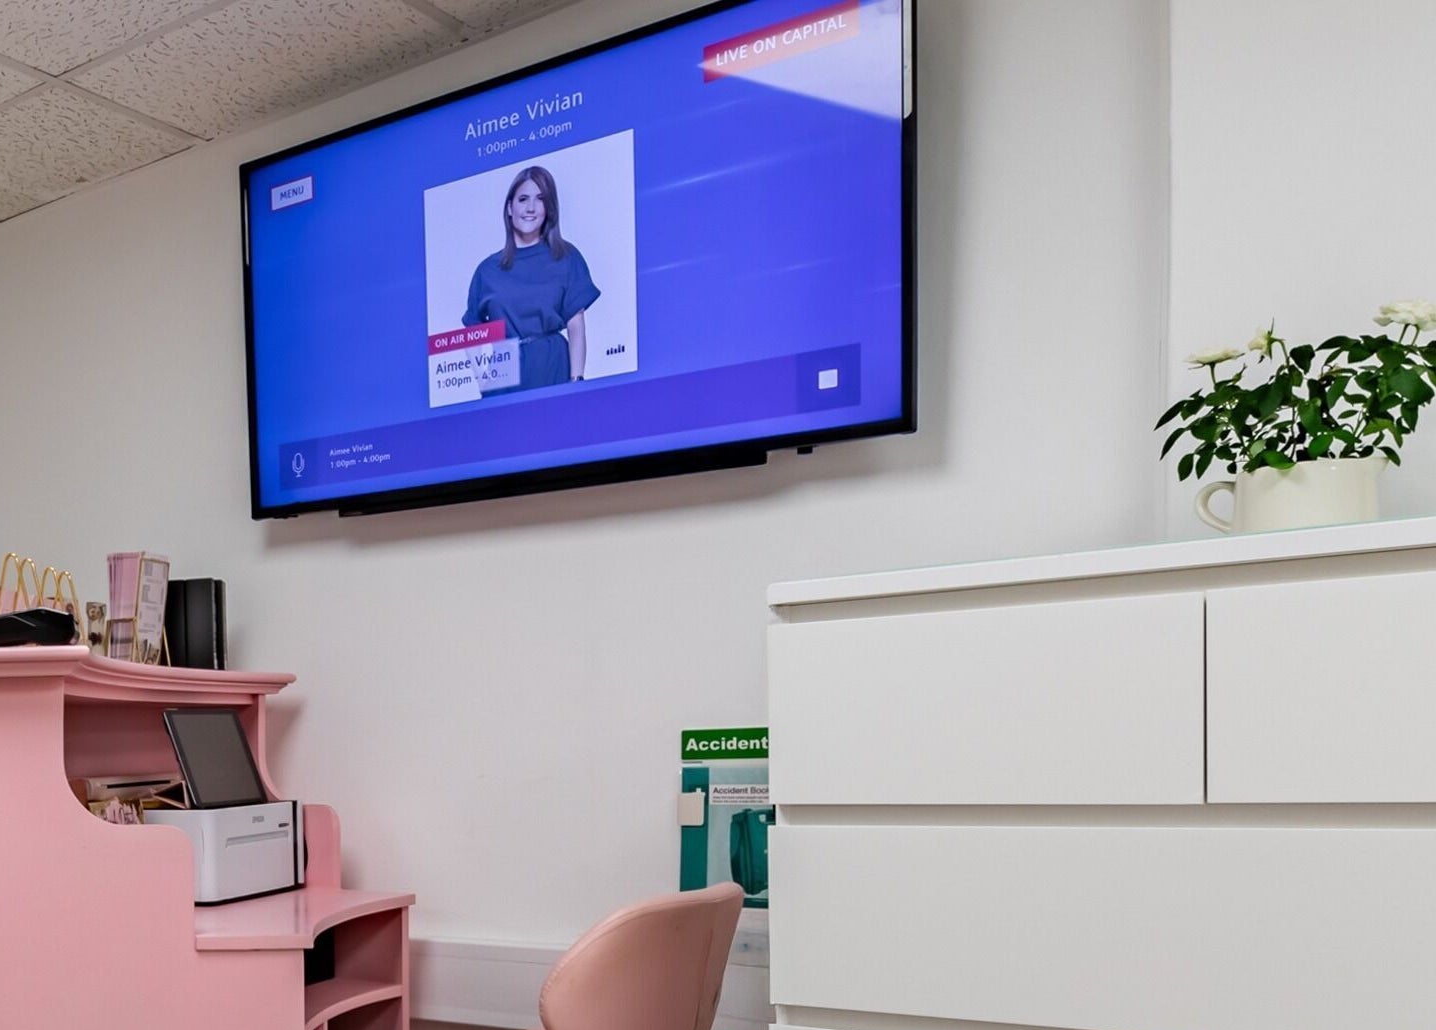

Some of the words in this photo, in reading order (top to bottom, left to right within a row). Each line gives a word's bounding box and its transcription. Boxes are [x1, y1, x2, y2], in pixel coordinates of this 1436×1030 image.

[715, 44, 749, 67] LIVE
[752, 35, 777, 55] ON
[782, 14, 847, 45] CAPITAL
[464, 111, 520, 141] Aimee
[526, 90, 583, 121] Vivian
[477, 138, 517, 157] 1:00pm
[528, 121, 572, 142] 4:00pm
[279, 185, 305, 201] MENU
[434, 338, 448, 349] ON
[450, 334, 465, 345] AIR
[467, 328, 489, 342] NOW
[435, 359, 472, 375] Aimee
[475, 350, 511, 367] Vivian
[437, 375, 472, 389] 1:00pm
[329, 448, 350, 457] Aimee
[352, 443, 373, 454] Vivian
[686, 736, 768, 751] Accident
[712, 786, 748, 795] Accident
